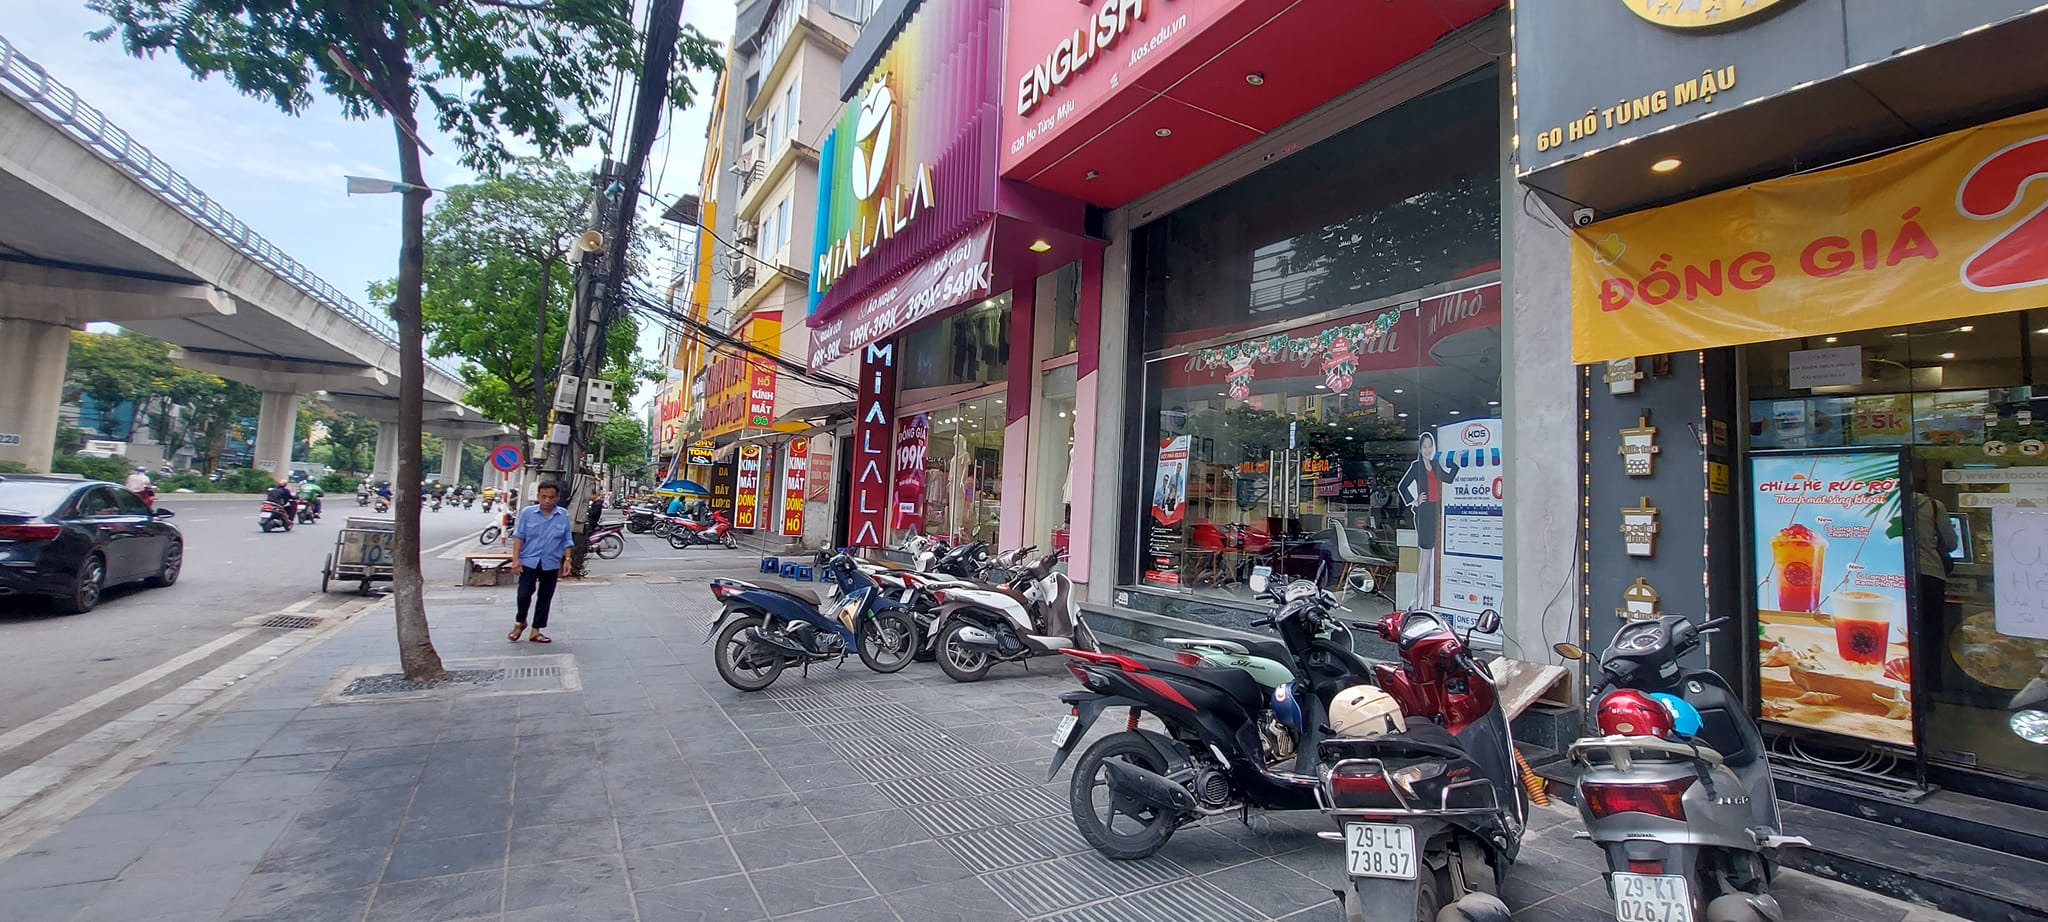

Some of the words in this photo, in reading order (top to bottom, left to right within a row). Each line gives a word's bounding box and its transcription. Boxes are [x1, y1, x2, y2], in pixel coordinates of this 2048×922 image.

[1018, 0, 1144, 115] ENGLISH
[1537, 127, 1564, 152] 60
[1568, 106, 1598, 141] HỒ
[1602, 90, 1668, 129] TÙNG
[1674, 65, 1736, 104] MẬU
[1599, 253, 1776, 314] ĐỒNG
[1800, 206, 1940, 278] GIÁ
[751, 388, 774, 400] KÍNH
[751, 400, 772, 415] MẮT
[1467, 429, 1486, 438] KOS
[740, 456, 758, 471] KÍNH
[788, 454, 806, 469] KÍNH
[897, 445, 926, 471] 199K
[740, 471, 757, 488] MẮT
[788, 471, 804, 490] MẮT
[1803, 478, 1822, 491] HÈ
[1828, 480, 1865, 494] RỰC
[1868, 477, 1894, 492] RỠ
[1455, 484, 1470, 495] TRẢ
[1471, 485, 1491, 495] GÓP
[738, 490, 756, 507] ĐỒNG
[786, 493, 804, 511] ĐỒNG
[739, 508, 752, 524] HỒ
[786, 513, 800, 531] HỒ
[1457, 616, 1469, 625] ONE
[1355, 826, 1402, 850] 29-L1
[1351, 850, 1409, 875] 738.97
[1623, 876, 1677, 900] 29-K1
[1620, 901, 1686, 922] 026.73
